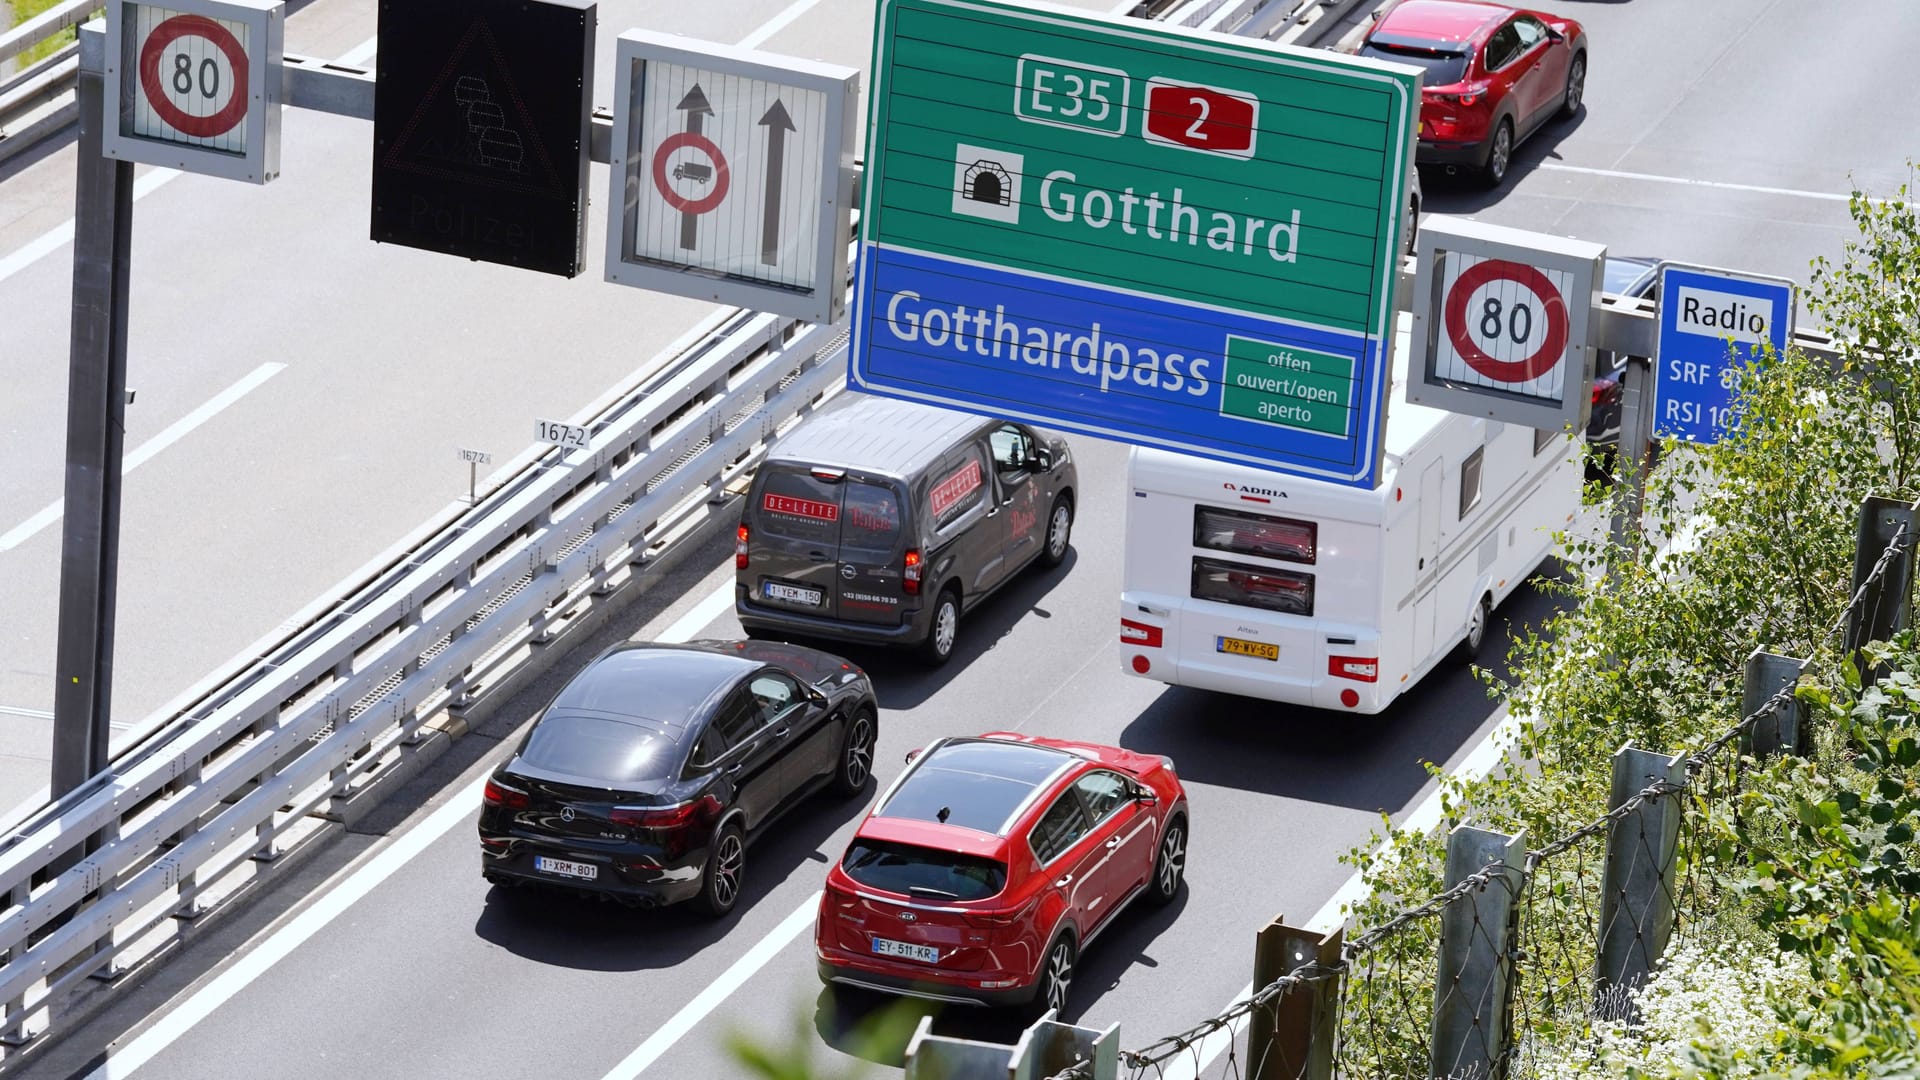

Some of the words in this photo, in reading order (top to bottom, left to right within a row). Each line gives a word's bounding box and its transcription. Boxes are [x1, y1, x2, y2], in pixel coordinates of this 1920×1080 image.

[173, 53, 219, 99] 80
[1032, 69, 1110, 121] E35
[1185, 97, 1210, 140] 2
[410, 194, 536, 249] Polizei
[1040, 169, 1300, 263] Gotthard
[1480, 297, 1531, 344] 80
[1683, 297, 1764, 333] Radio
[887, 290, 1210, 396] Gotthardpass
[1268, 351, 1311, 373] offen
[1237, 373, 1338, 404] ouvert/open
[1669, 360, 1711, 385] SRF
[1258, 401, 1311, 422] aperto
[1666, 398, 1701, 424] RSI
[1240, 485, 1288, 498] ADRIA
